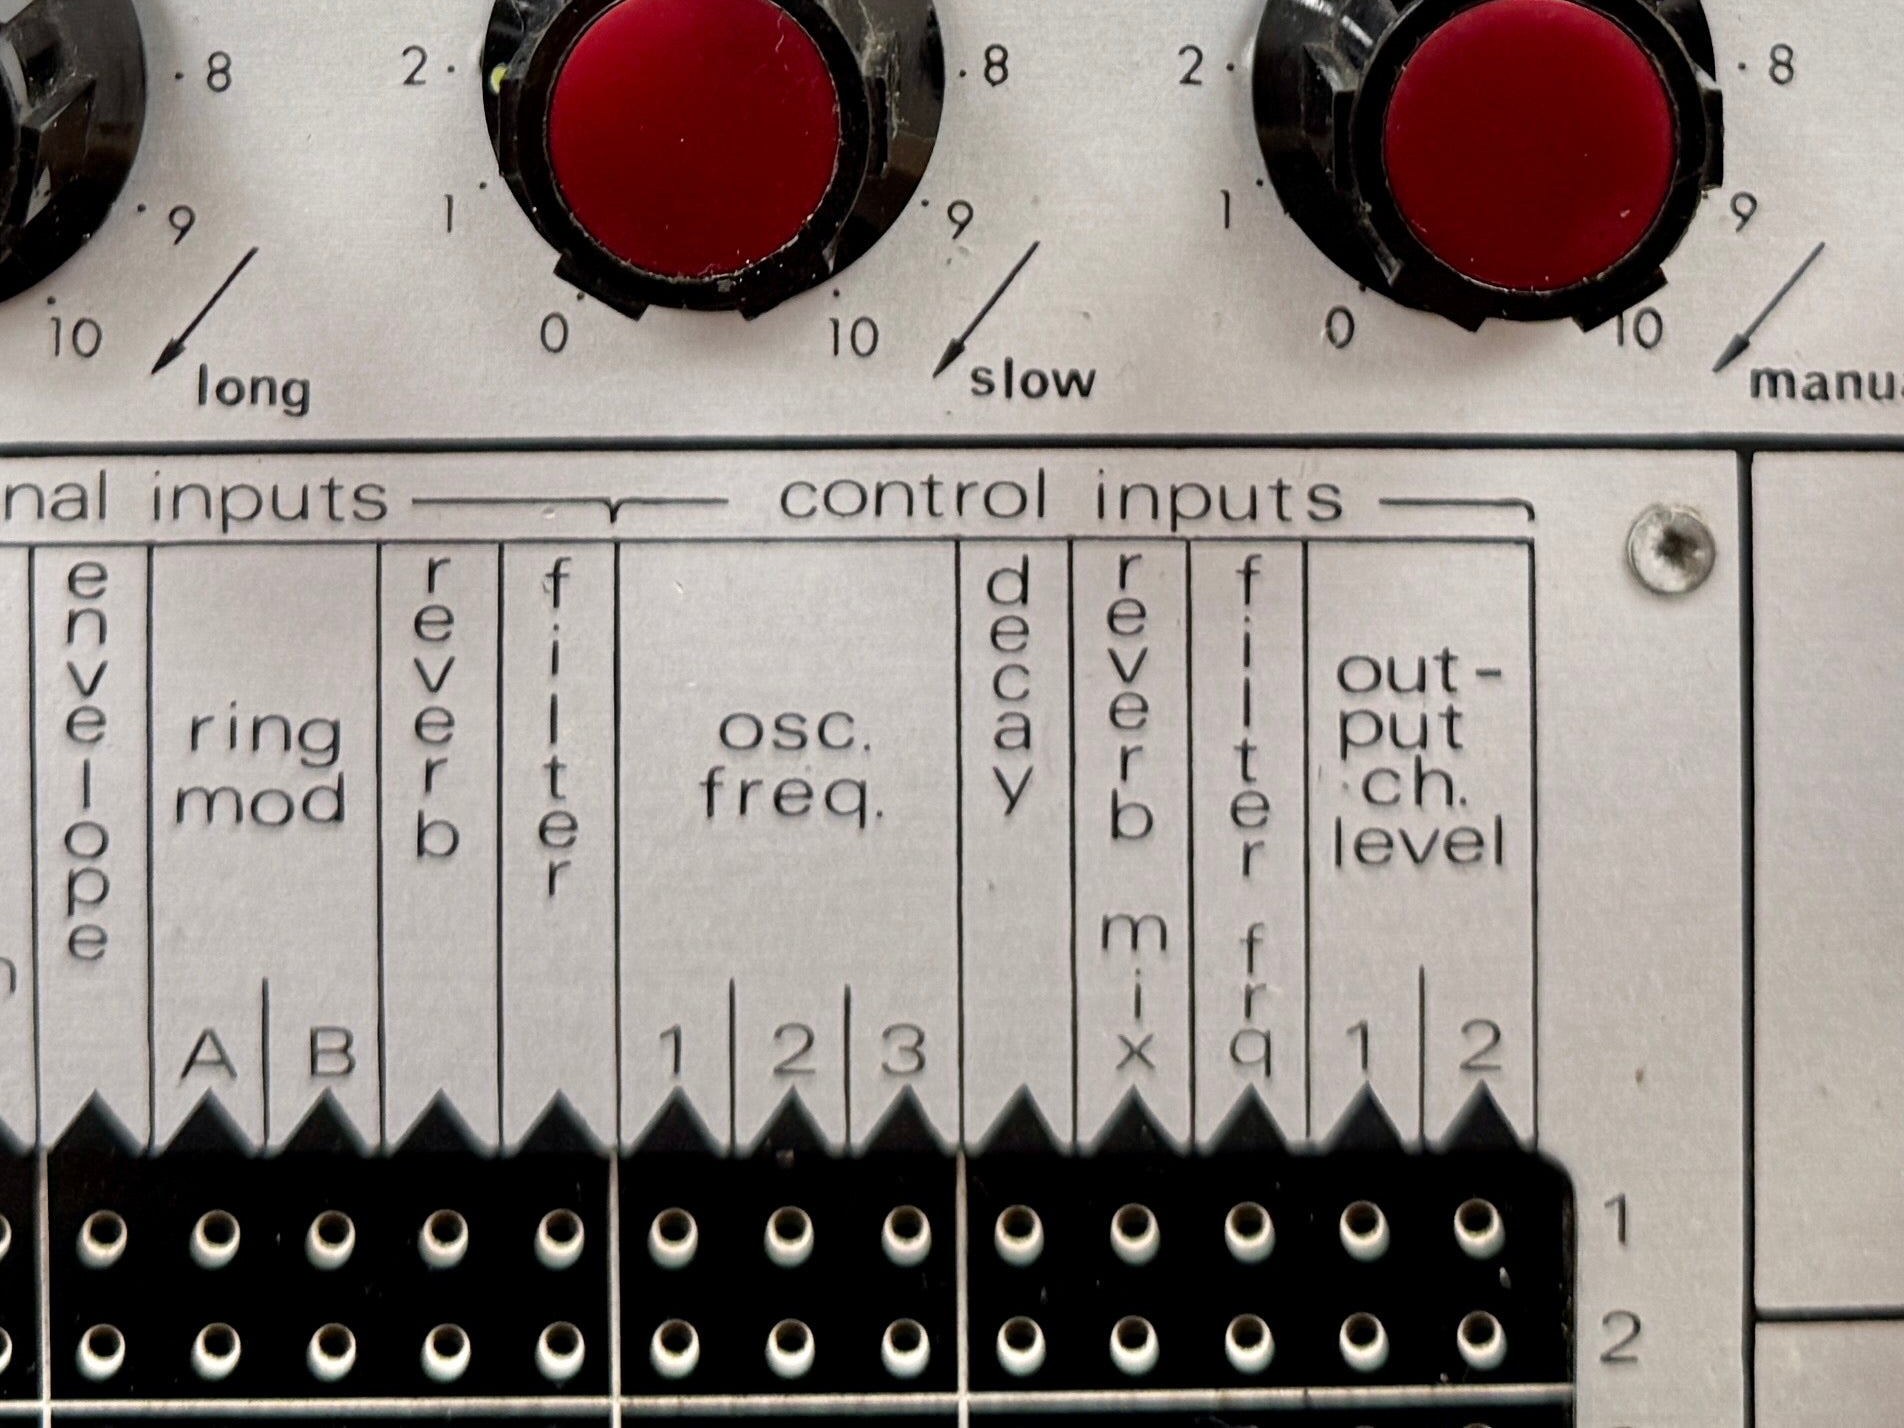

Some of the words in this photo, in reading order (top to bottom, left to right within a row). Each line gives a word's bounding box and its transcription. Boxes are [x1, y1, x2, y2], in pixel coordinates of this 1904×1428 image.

[401, 44, 428, 87] 2
[947, 199, 974, 242] 9
[50, 316, 103, 360] 10
[1325, 305, 1355, 351] 0
[196, 363, 310, 421] long
[970, 356, 1096, 402] slow
[152, 470, 388, 536] inputs
[780, 467, 1045, 522] control
[1097, 468, 1344, 532] inputs
[190, 700, 340, 772] ring
[718, 711, 870, 758] osc.
[1339, 703, 1463, 767] put
[172, 771, 345, 833] mod
[698, 765, 883, 835] freq.
[1361, 754, 1467, 812] ch.
[1335, 814, 1505, 872] level
[176, 1028, 237, 1088] A
[308, 1026, 356, 1085] B
[659, 1024, 682, 1081] 1
[773, 1022, 816, 1083] 2
[882, 1023, 926, 1080] 3
[1346, 1020, 1370, 1076] 1
[1460, 1019, 1502, 1076] 2
[1604, 1193, 1629, 1249] 1
[1600, 1310, 1642, 1368] 2
